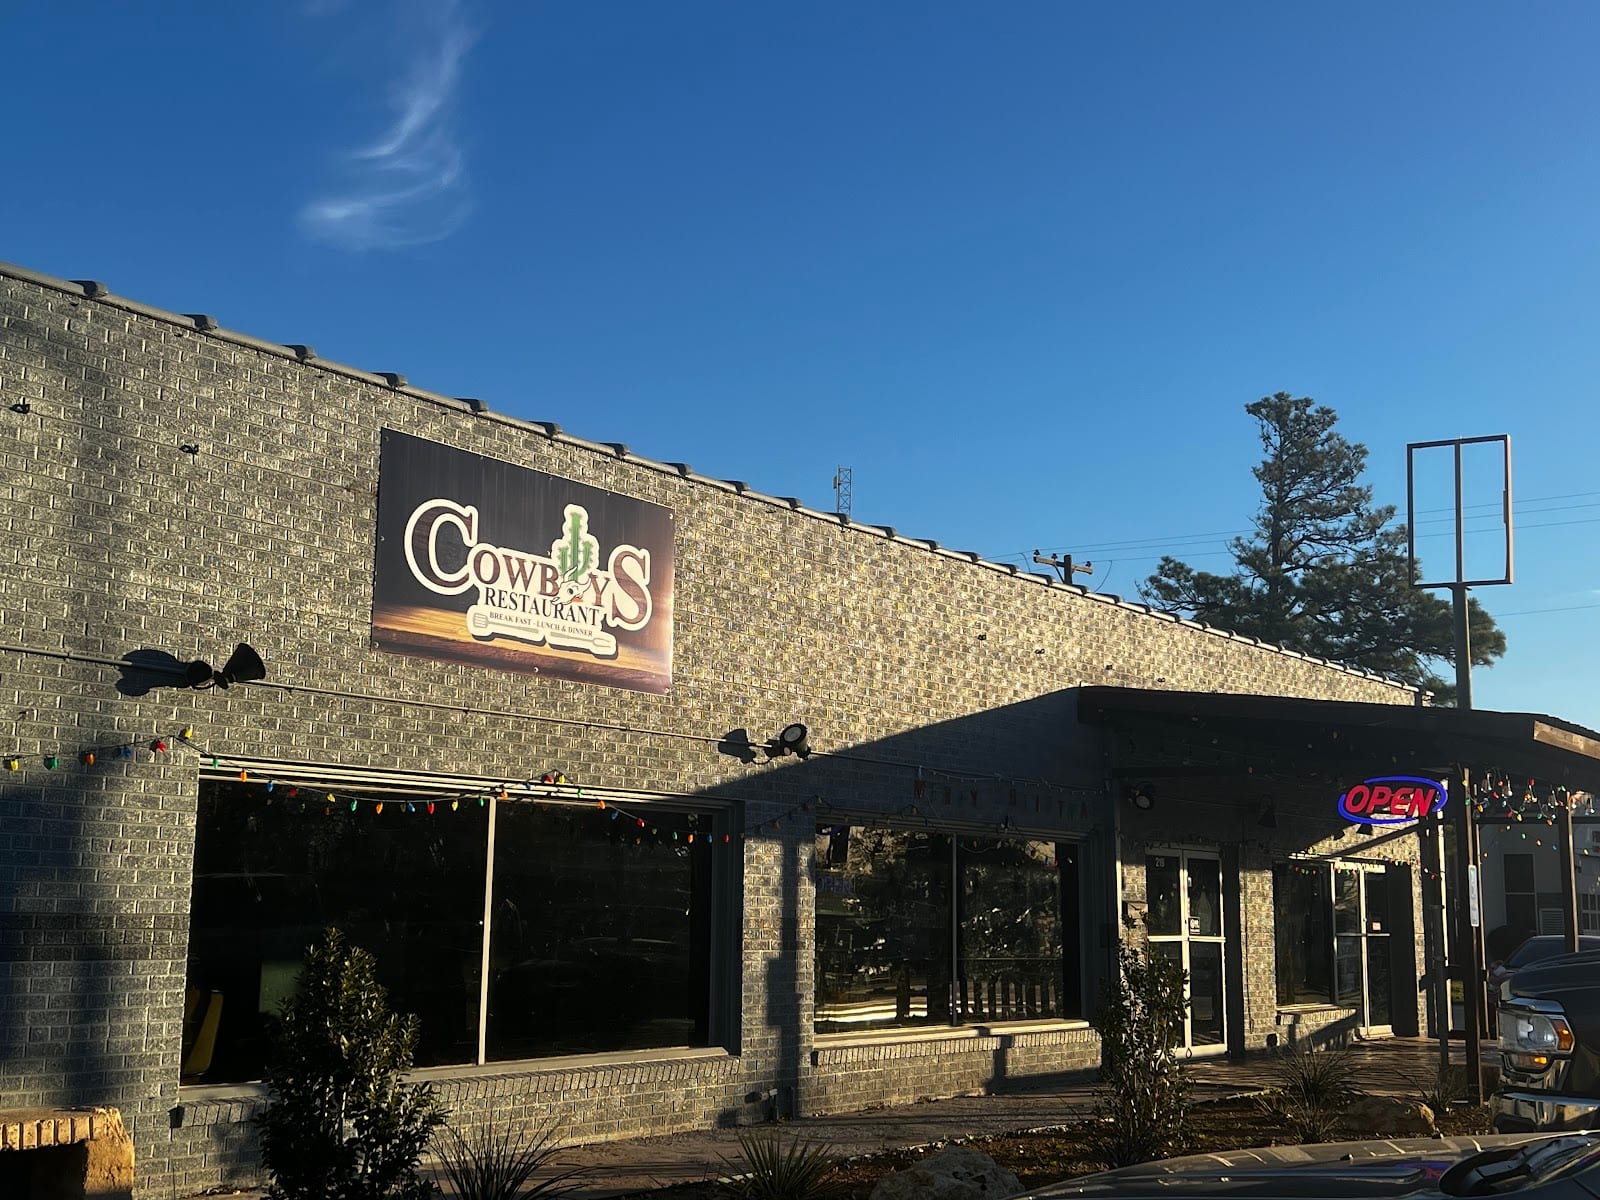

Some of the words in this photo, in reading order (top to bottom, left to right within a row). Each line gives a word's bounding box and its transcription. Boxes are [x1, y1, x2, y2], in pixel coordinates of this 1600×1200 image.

[408, 502, 650, 628] COWBYS
[485, 587, 600, 626] RESTAURANT
[489, 611, 515, 623] BREAK
[515, 616, 532, 626] FAST
[536, 620, 560, 631] LUNCH
[568, 627, 593, 637] DINNER
[1345, 785, 1436, 816] OPEN
[816, 874, 852, 895] OPEN
